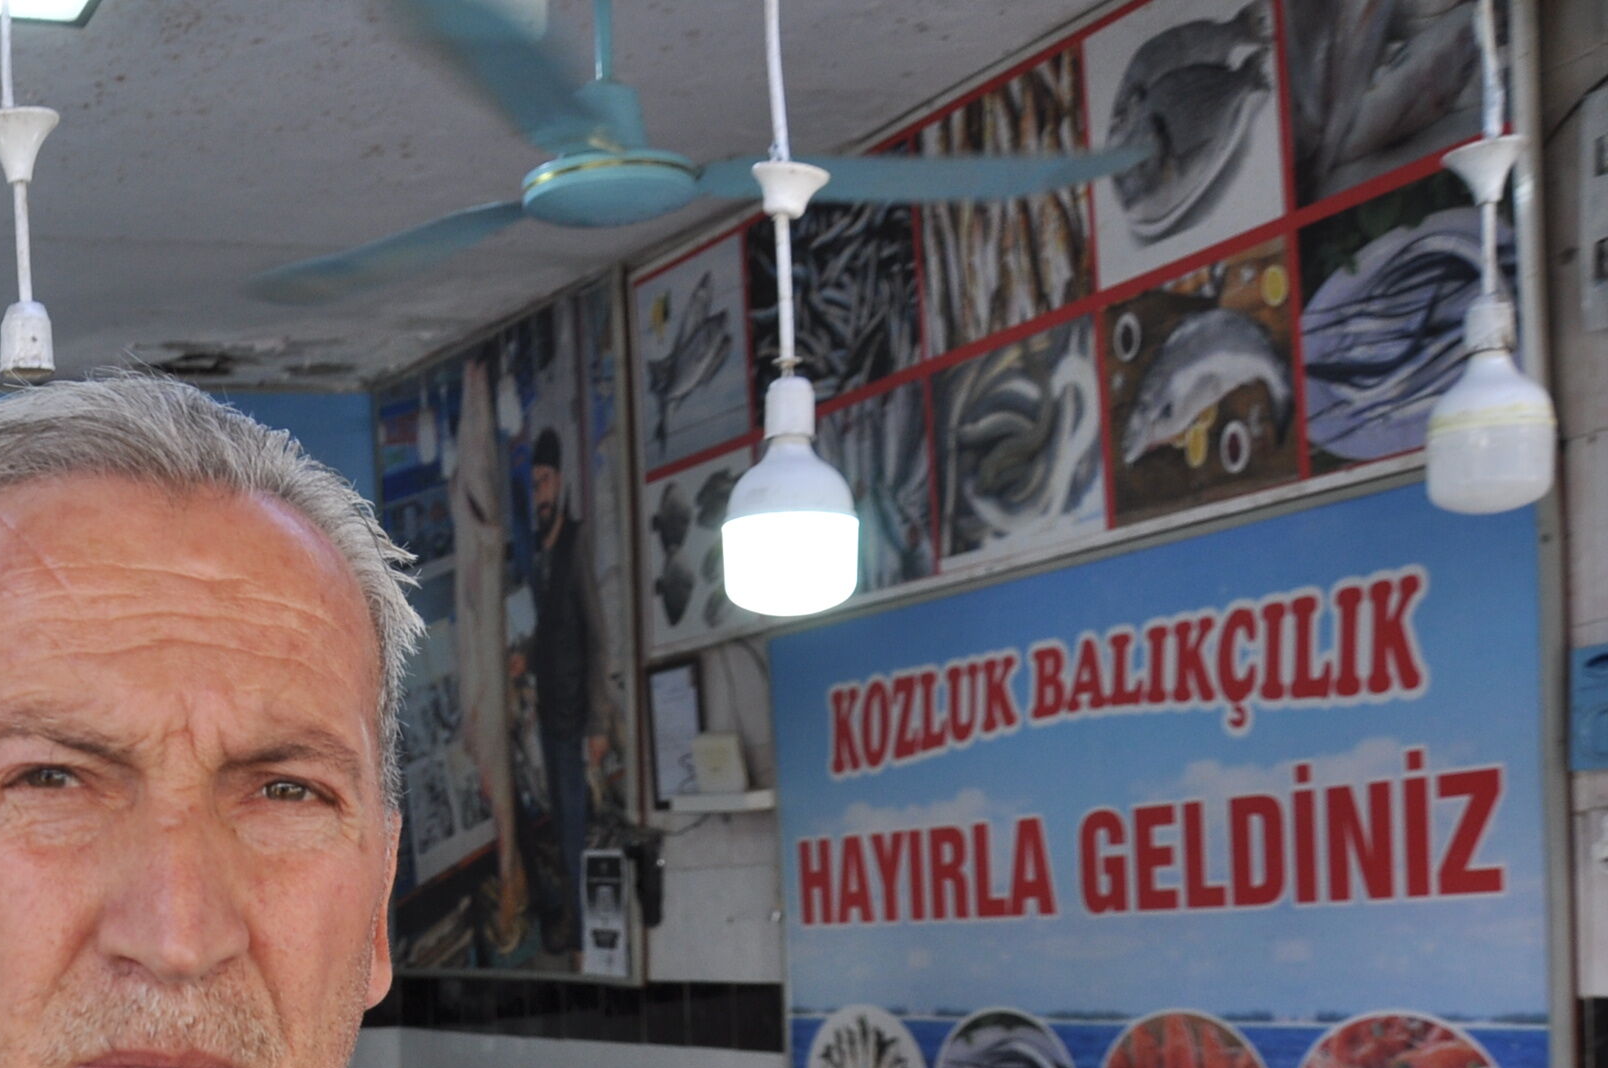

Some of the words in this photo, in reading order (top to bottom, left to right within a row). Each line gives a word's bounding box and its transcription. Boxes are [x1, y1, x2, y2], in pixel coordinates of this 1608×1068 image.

[829, 654, 1019, 774] KOZLUK
[1030, 574, 1421, 729] BALIKÇILIK
[798, 816, 1058, 926] HAYIRLA
[1079, 749, 1505, 917] GELDİNİZ
